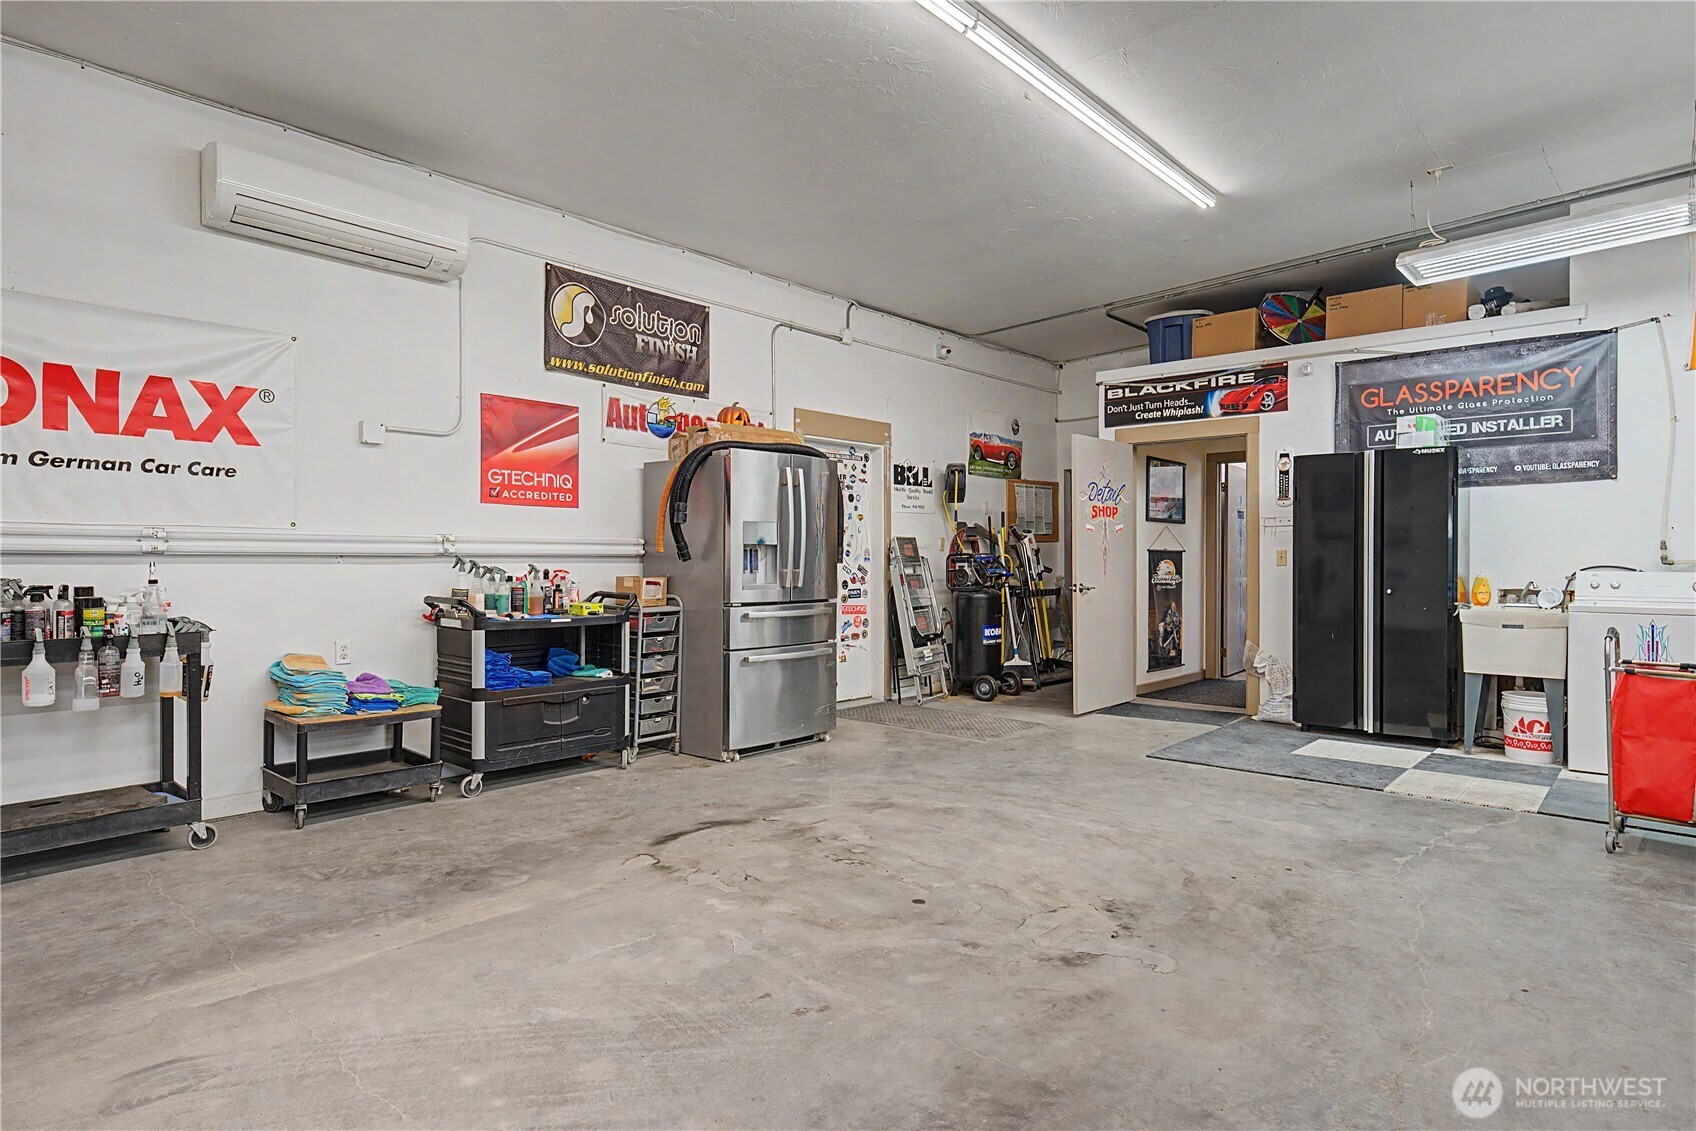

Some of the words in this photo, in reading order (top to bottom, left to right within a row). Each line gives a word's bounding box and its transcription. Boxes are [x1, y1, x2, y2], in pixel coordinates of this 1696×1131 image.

[609, 302, 702, 345] solution
[634, 333, 699, 365] FINISH
[549, 356, 705, 392] www.solutionfinish.com
[1106, 372, 1256, 400] BLACKFIRE
[1360, 364, 1583, 409] GLASSPARENCY
[1107, 403, 1128, 414] Don't
[1128, 401, 1144, 412] Just
[1144, 400, 1162, 411] Turn
[1163, 397, 1195, 408] Heads...
[1135, 411, 1162, 420] Create
[1162, 405, 1204, 418] Whiplash!
[1386, 408, 1405, 416] The
[1409, 403, 1453, 414] Ultimate
[1457, 400, 1488, 410] Glass
[1492, 394, 1554, 406] Protection
[1471, 414, 1564, 435] INSTALLER
[28, 450, 132, 472] German
[140, 458, 181, 475] Car
[187, 461, 237, 478] Care
[1522, 464, 1552, 472] YOUTUBE:
[488, 468, 573, 489] GTECHNIQ
[893, 464, 933, 488] BILL
[502, 489, 573, 502] ACCREDITED
[1088, 480, 1126, 505] Detail
[1091, 505, 1119, 520] SHOP
